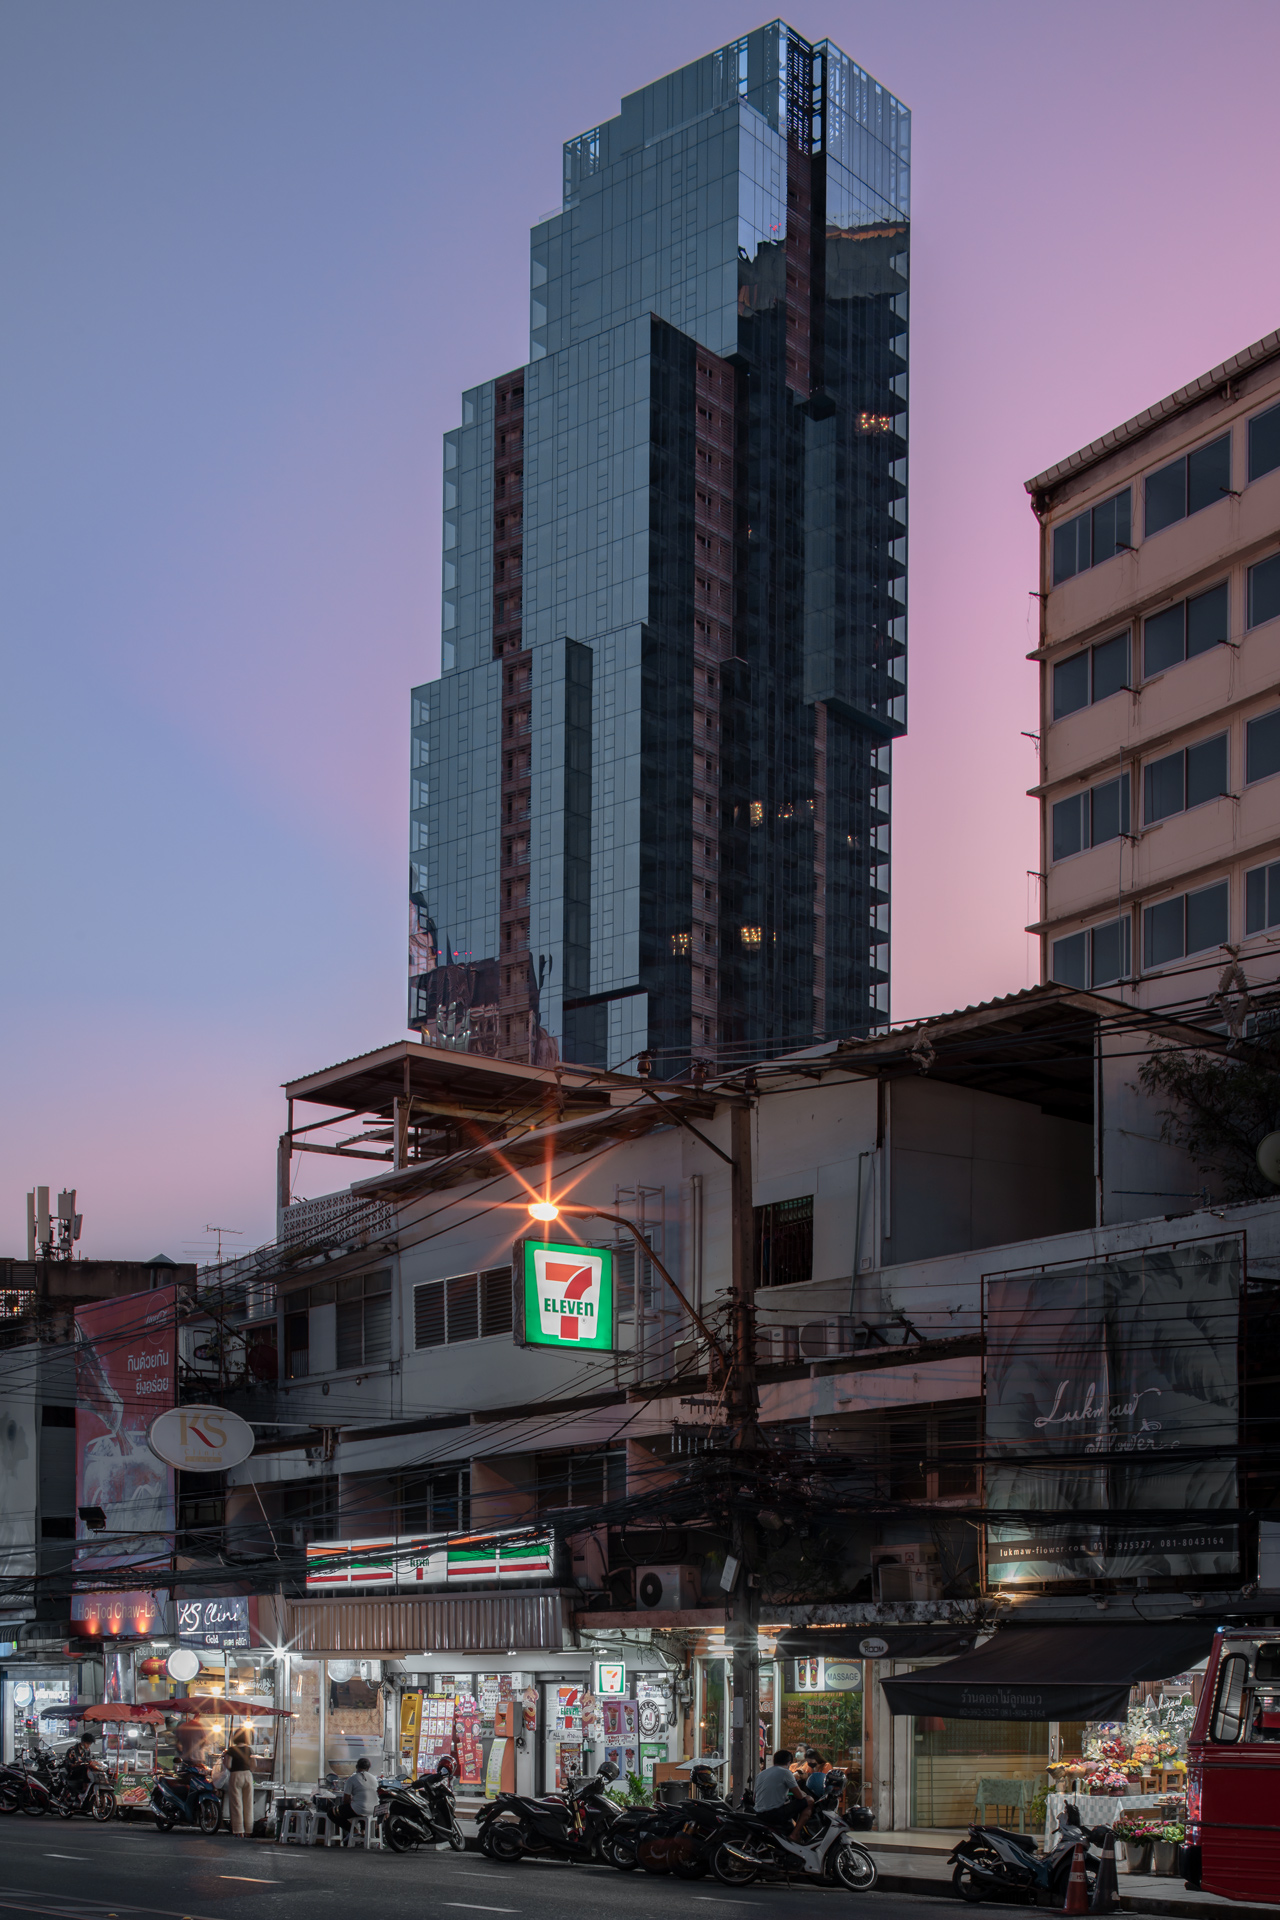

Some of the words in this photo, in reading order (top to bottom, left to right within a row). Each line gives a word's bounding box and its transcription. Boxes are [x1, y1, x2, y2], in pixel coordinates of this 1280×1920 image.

[545, 1261, 593, 1340] 7
[127, 1349, 169, 1372] กินด้วยกัน
[136, 1373, 169, 1396] ยิ่งอร่อย
[179, 1412, 228, 1449] KS
[184, 1448, 222, 1457] Clinic
[999, 1544, 1086, 1557] lukmaw-flower.com
[1160, 1537, 1224, 1548] 081-8043164
[77, 1602, 113, 1620] Hoi-Tod
[179, 1602, 203, 1632] KS
[205, 1634, 219, 1644] Gold
[827, 1672, 859, 1681] MASSAGE
[960, 1688, 1043, 1709] ร้านดอกไม้ลูกแมว
